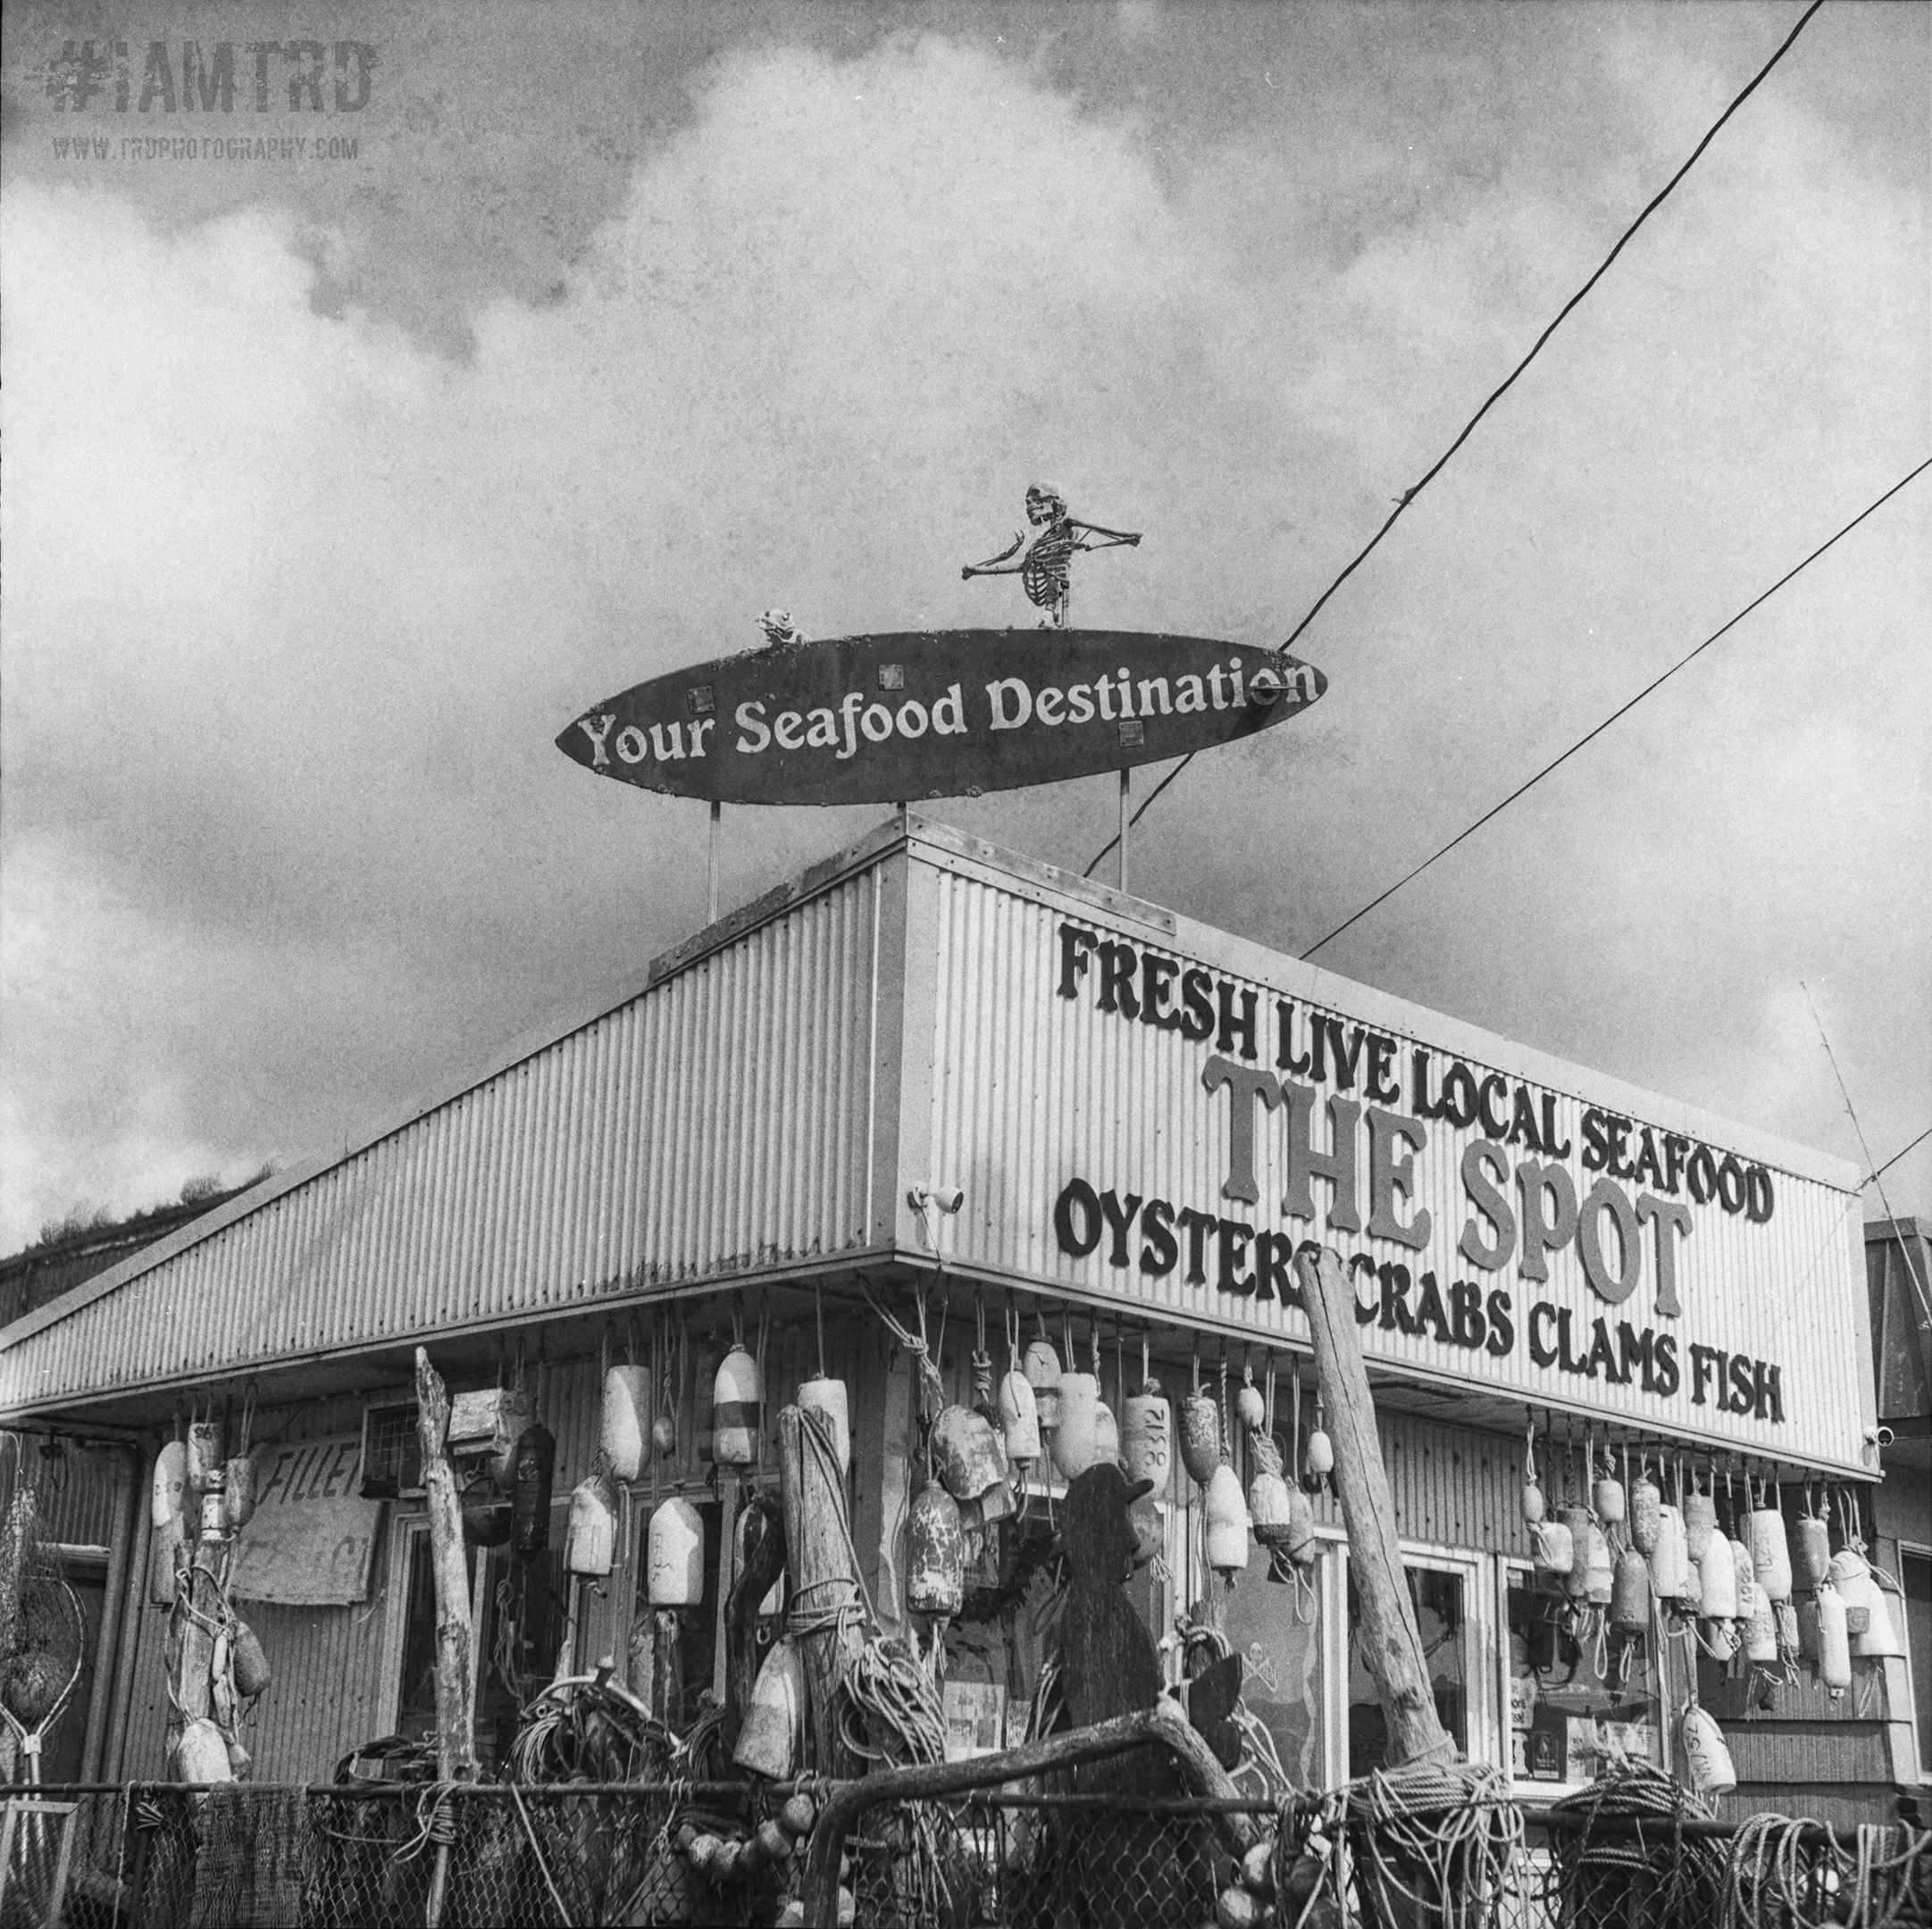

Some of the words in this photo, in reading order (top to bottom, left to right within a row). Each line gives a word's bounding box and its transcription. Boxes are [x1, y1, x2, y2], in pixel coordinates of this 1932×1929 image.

[578, 714, 715, 765] Your
[734, 682, 968, 759] Seafood
[985, 656, 1320, 731] Destination
[1057, 922, 1258, 1061] FRESH
[1275, 998, 1401, 1104] LIVE
[1412, 1048, 1571, 1159] LOCAL
[1581, 1107, 1774, 1223] SEAFOOD
[1202, 1054, 1431, 1250] THE
[1459, 1138, 1693, 1318] SPOT
[1349, 1252, 1514, 1356] CRABS
[1528, 1301, 1679, 1396] CLAMS
[1688, 1341, 1786, 1424] FISH
